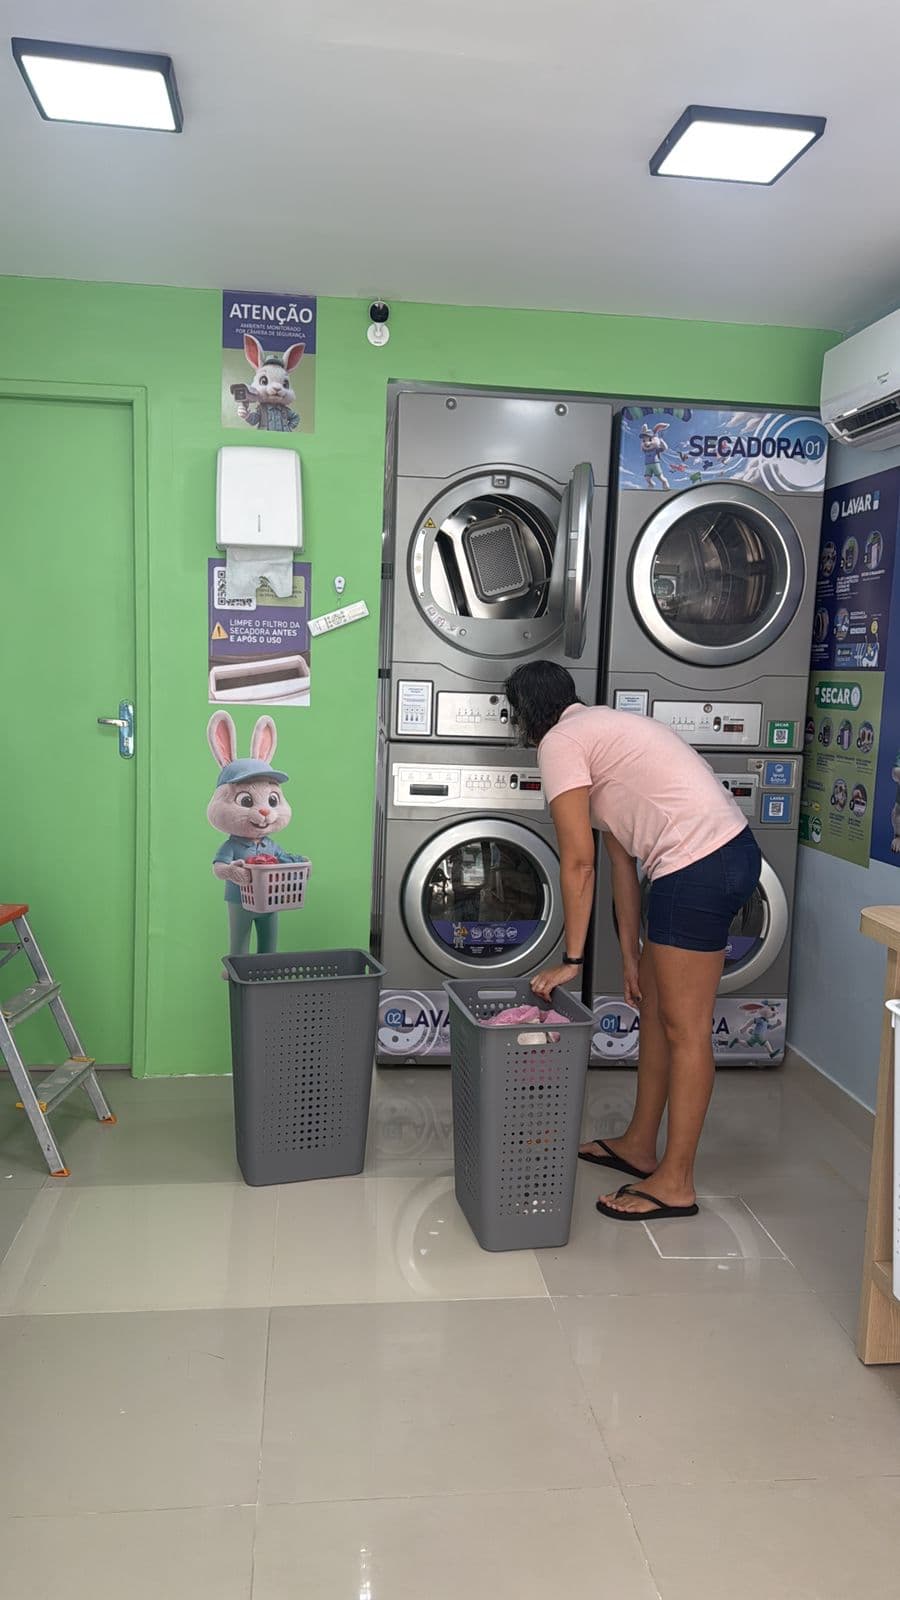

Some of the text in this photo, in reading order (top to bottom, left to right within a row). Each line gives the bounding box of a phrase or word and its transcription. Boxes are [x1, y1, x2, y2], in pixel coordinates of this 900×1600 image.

[229, 303, 313, 325] ATENÇÃO
[240, 323, 302, 333] AMBIENTE MONITORADO
[688, 435, 821, 460] SECADORA 01
[841, 493, 872, 518] LAVAR
[229, 619, 253, 628] LIMPE
[262, 620, 288, 629] FILTRO
[289, 621, 301, 629] DA
[229, 627, 298, 637] SECADORA ANTES
[266, 636, 282, 644] USO
[820, 687, 851, 705] SECAR
[386, 1012, 401, 1025] 02
[602, 1017, 615, 1031] 01
